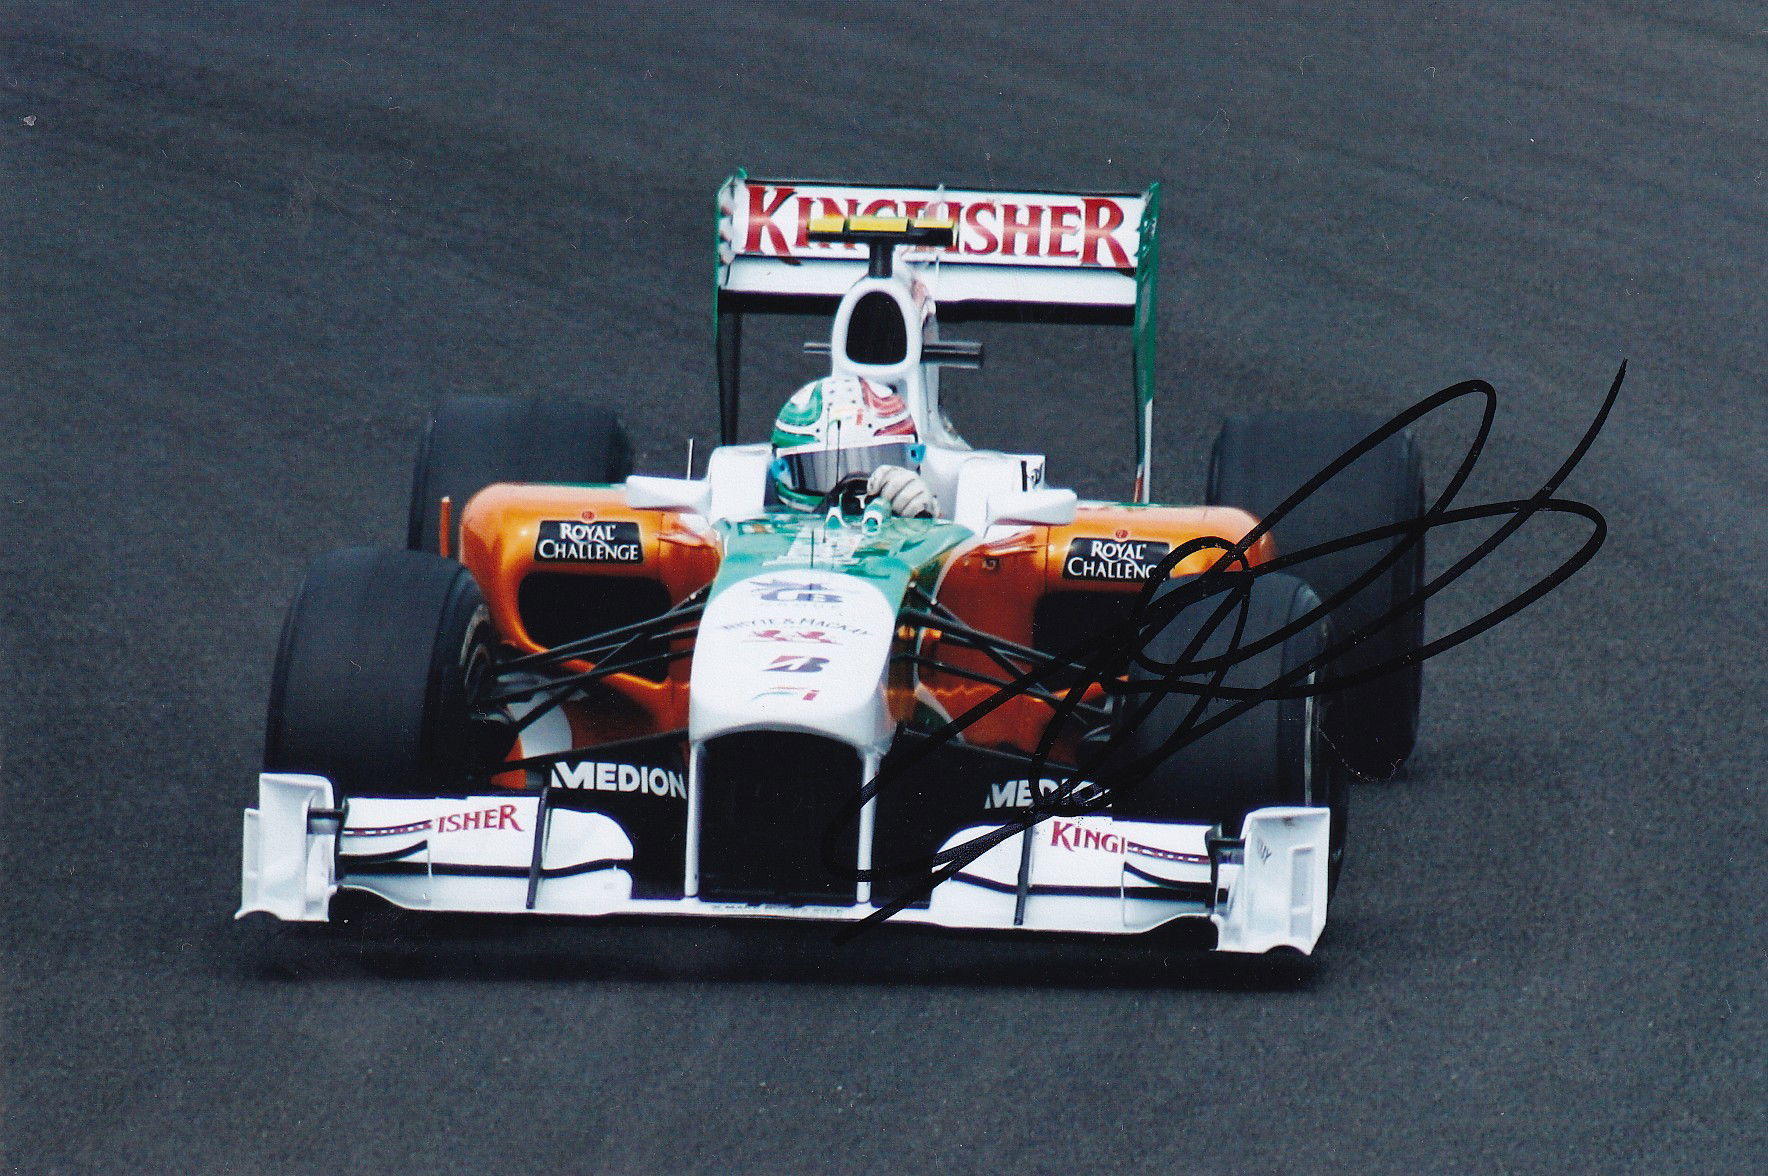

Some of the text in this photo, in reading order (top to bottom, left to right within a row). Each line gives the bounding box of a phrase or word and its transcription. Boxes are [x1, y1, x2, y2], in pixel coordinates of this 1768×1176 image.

[559, 523, 616, 542] ROYAL
[538, 539, 639, 561] CHALLENGE
[1090, 540, 1147, 560] ROYAL
[1067, 556, 1158, 579] CHALLEN
[550, 761, 688, 800] MEDION
[984, 778, 1113, 810] MED
[437, 804, 525, 833] ISHER
